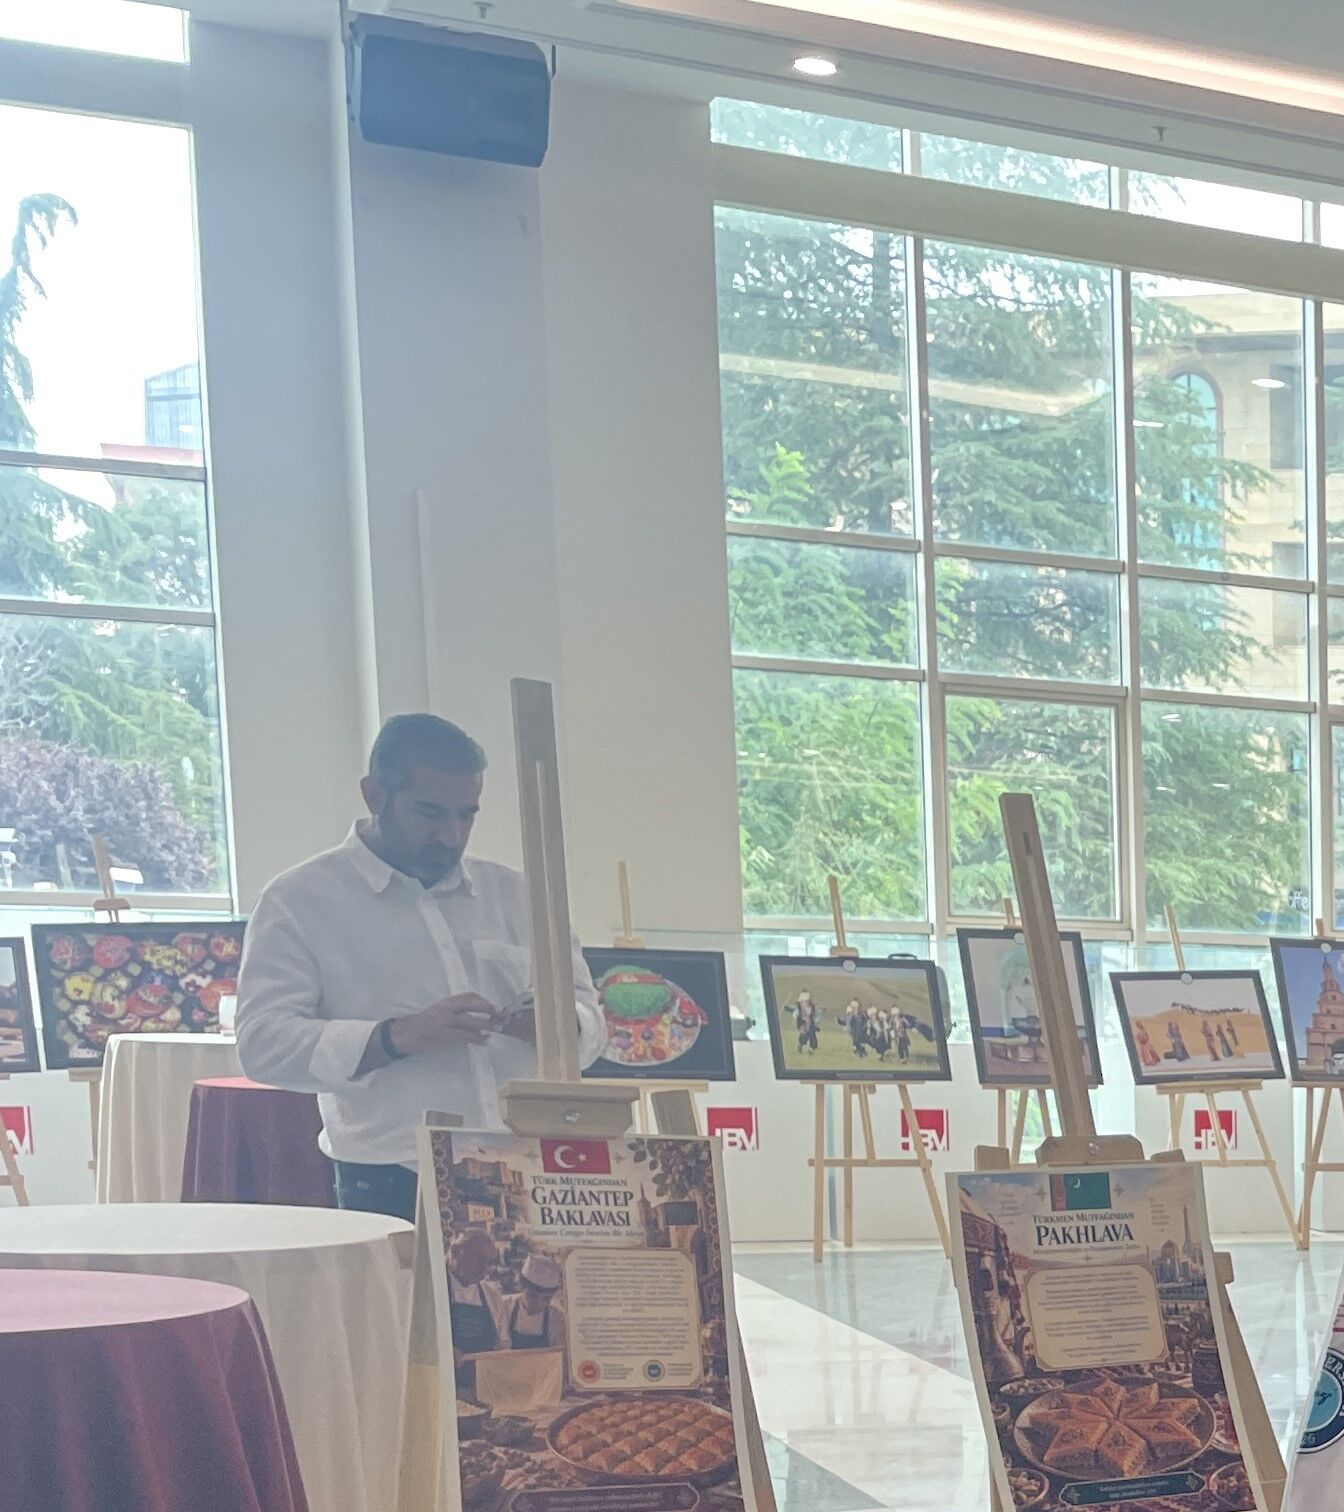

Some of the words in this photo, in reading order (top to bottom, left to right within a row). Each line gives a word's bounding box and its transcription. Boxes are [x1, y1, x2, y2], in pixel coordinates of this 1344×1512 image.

[531, 1185, 634, 1207] GAZİANTEP
[540, 1206, 631, 1227] BAKLAVASI
[1035, 1223, 1134, 1246] PAKHLAVA
